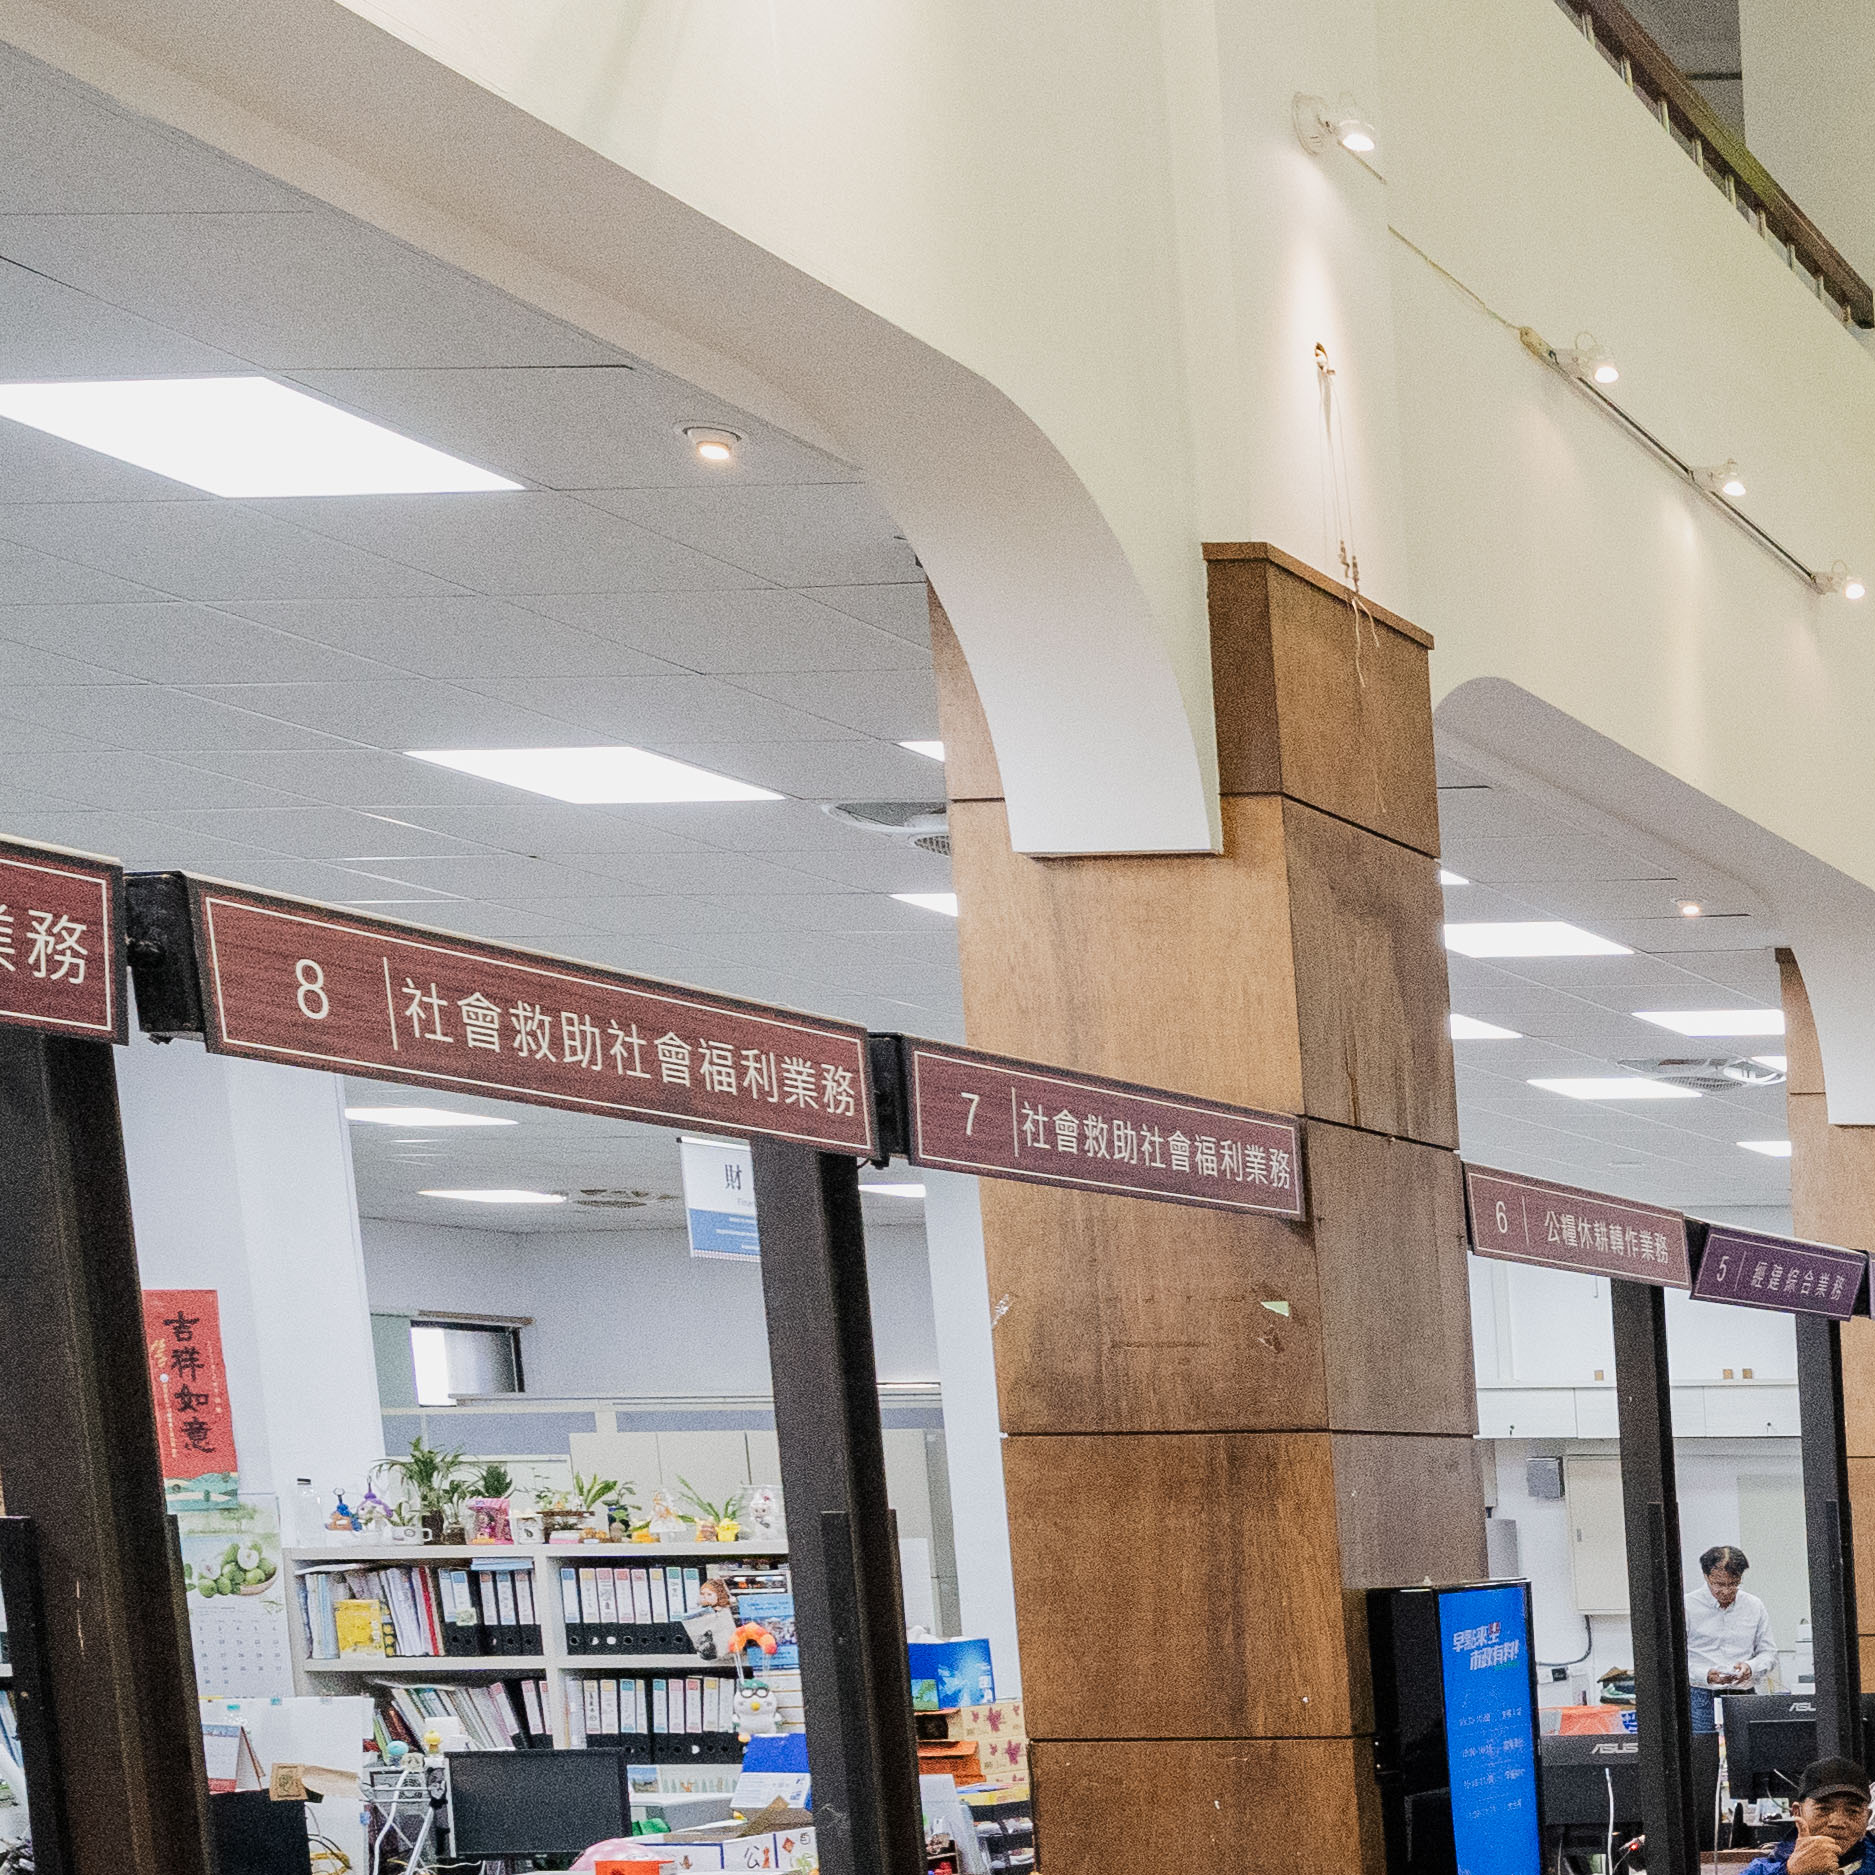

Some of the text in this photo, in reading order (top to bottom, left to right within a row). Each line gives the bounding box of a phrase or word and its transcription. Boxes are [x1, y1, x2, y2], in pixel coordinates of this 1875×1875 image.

[294, 958, 859, 1119] 8 社會救助社會福利業務
[959, 1092, 1293, 1192] 7 社會救助社會福利業務
[724, 1163, 743, 1191] 財
[1495, 1199, 1509, 1235] 6
[1715, 1254, 1729, 1284] 5
[163, 1310, 217, 1454] 吉祥如意
[1592, 1742, 1639, 1755] ASUS
